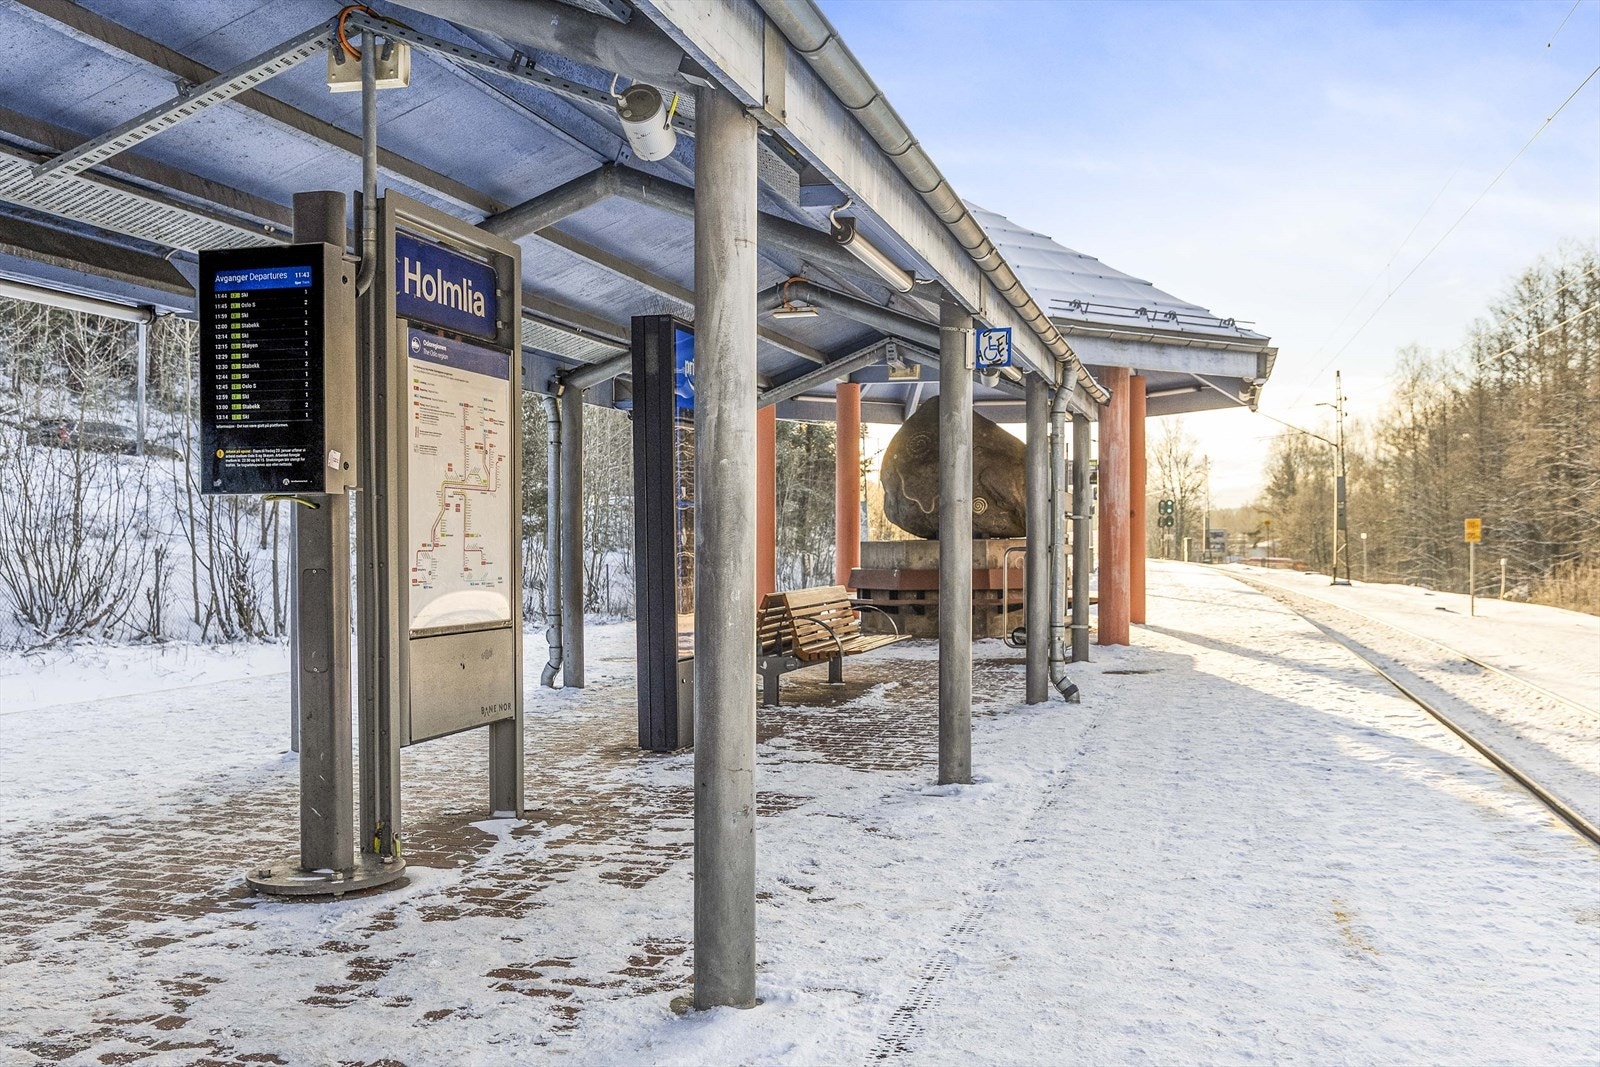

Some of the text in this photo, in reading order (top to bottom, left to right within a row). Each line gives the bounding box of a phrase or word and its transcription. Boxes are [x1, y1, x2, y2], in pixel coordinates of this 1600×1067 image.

[215, 272, 288, 284] Avganger Departures
[404, 256, 485, 318] Holmlia
[684, 358, 694, 377] pri
[480, 702, 511, 717] BANE NOR
